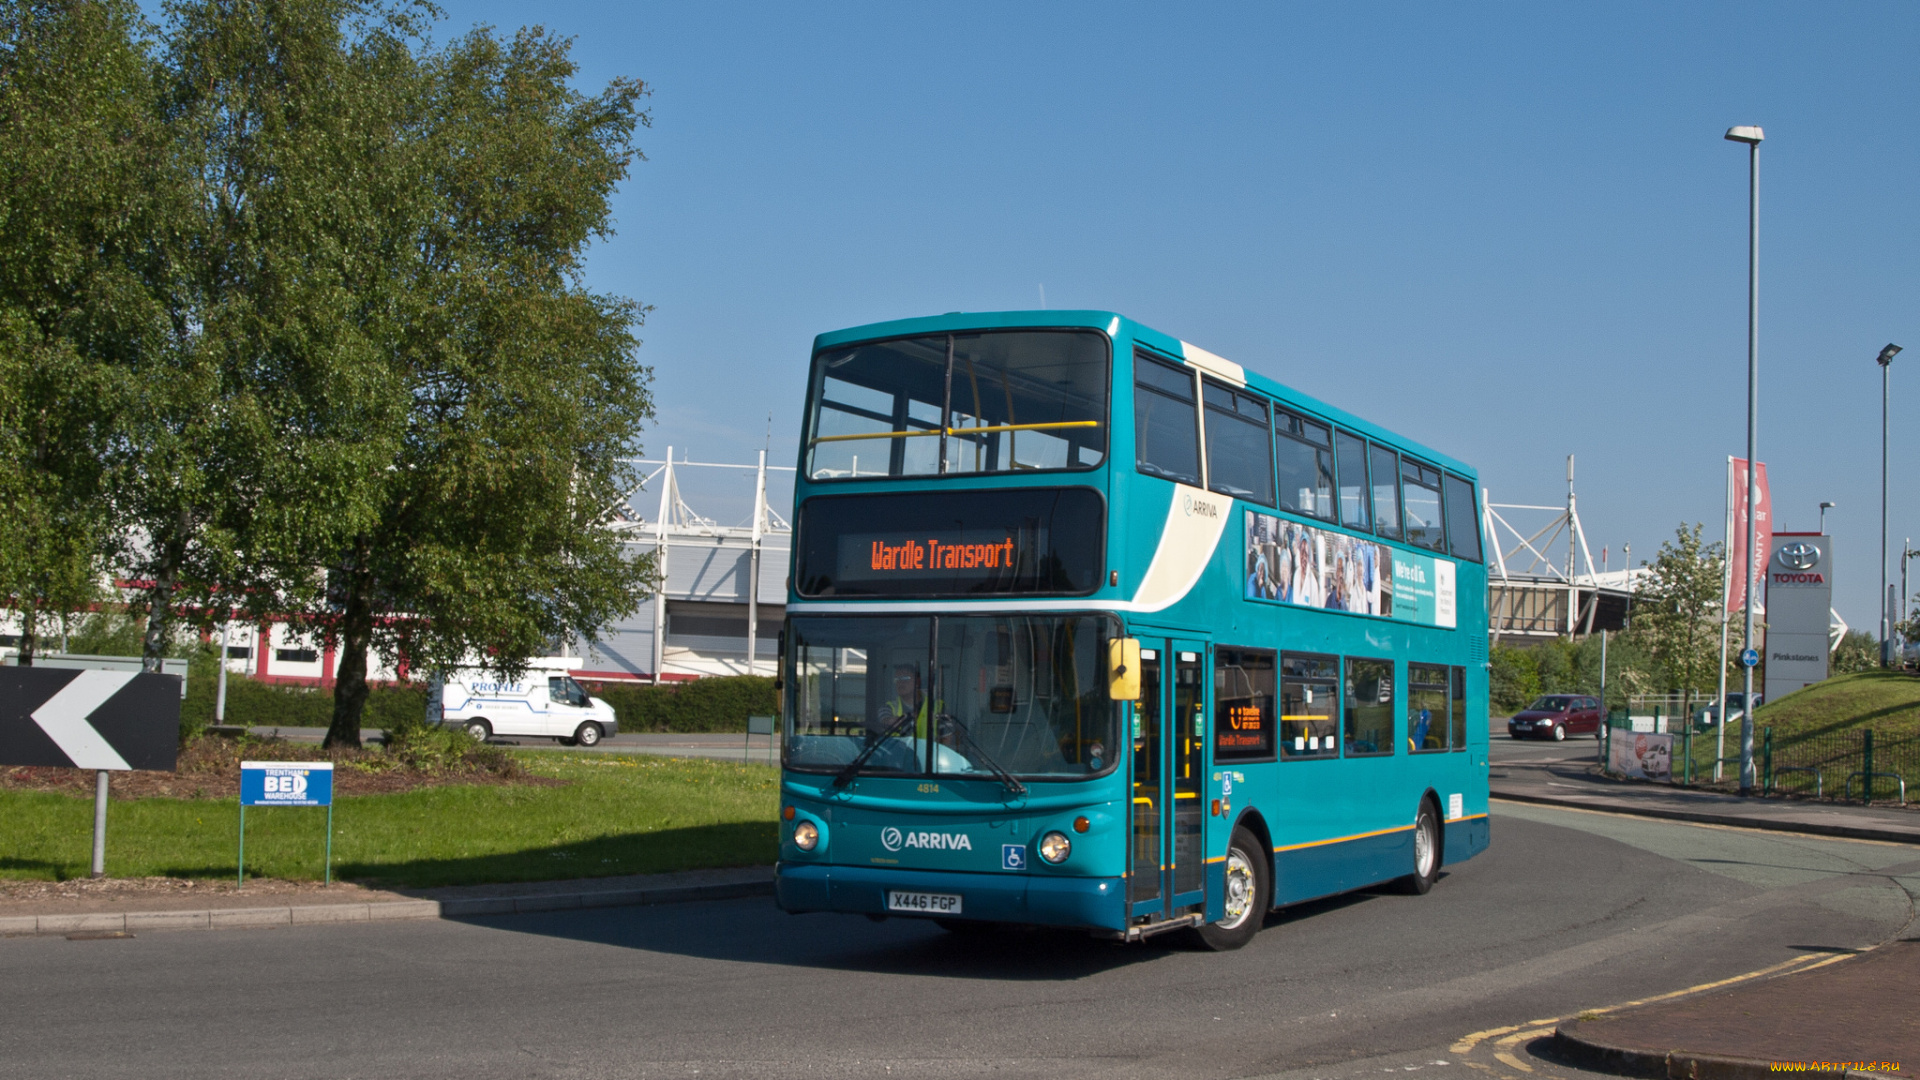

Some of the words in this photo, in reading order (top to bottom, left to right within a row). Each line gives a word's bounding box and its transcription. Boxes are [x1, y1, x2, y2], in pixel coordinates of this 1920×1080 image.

[1193, 501, 1218, 519] ARRIVA
[871, 540, 923, 570] Wardle
[928, 537, 1014, 569] Transport
[1773, 573, 1825, 584] TOYOTA
[1773, 653, 1820, 662] Pinkstones
[264, 775, 308, 793] BED
[917, 783, 939, 794] 4814
[264, 792, 307, 800] WAREHOUSE
[904, 831, 972, 851] ARRIVA
[894, 893, 928, 909] X446
[930, 896, 957, 911] FGP
